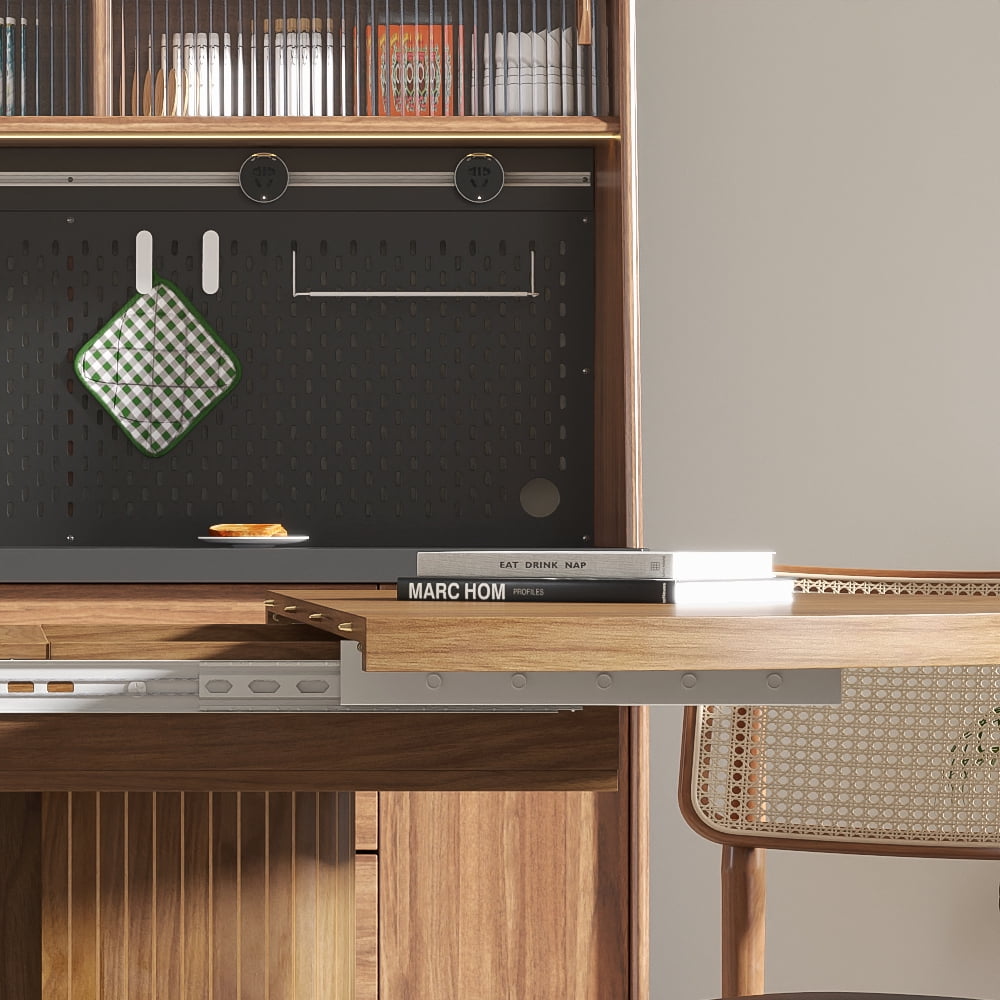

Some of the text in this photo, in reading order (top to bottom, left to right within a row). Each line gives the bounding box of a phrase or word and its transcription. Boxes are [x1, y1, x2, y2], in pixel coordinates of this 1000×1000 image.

[499, 561, 587, 569] EAT DRINK NAP
[408, 582, 506, 601] MARC HOM
[513, 588, 545, 597] PROFILES
